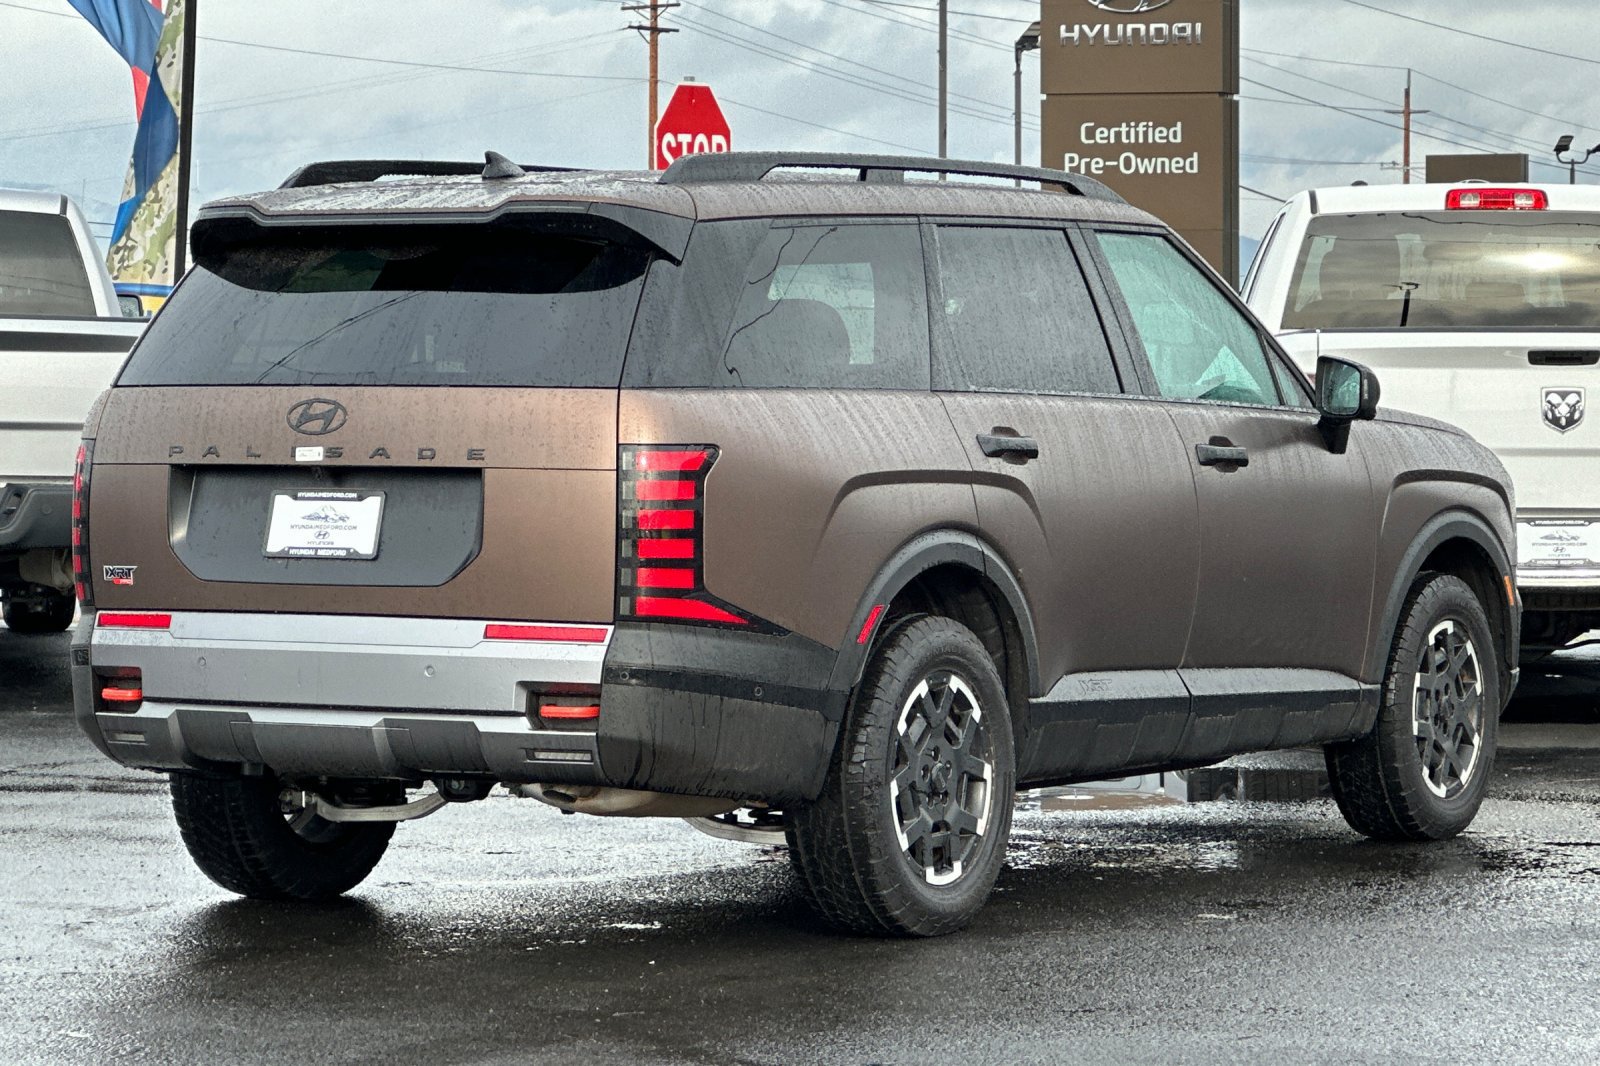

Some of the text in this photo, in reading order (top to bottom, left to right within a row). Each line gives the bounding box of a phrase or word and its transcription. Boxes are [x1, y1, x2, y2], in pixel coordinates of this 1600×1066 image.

[1059, 22, 1202, 46] HYUNDAI
[1080, 121, 1182, 144] Certified
[1064, 151, 1199, 175] Pre-Owned
